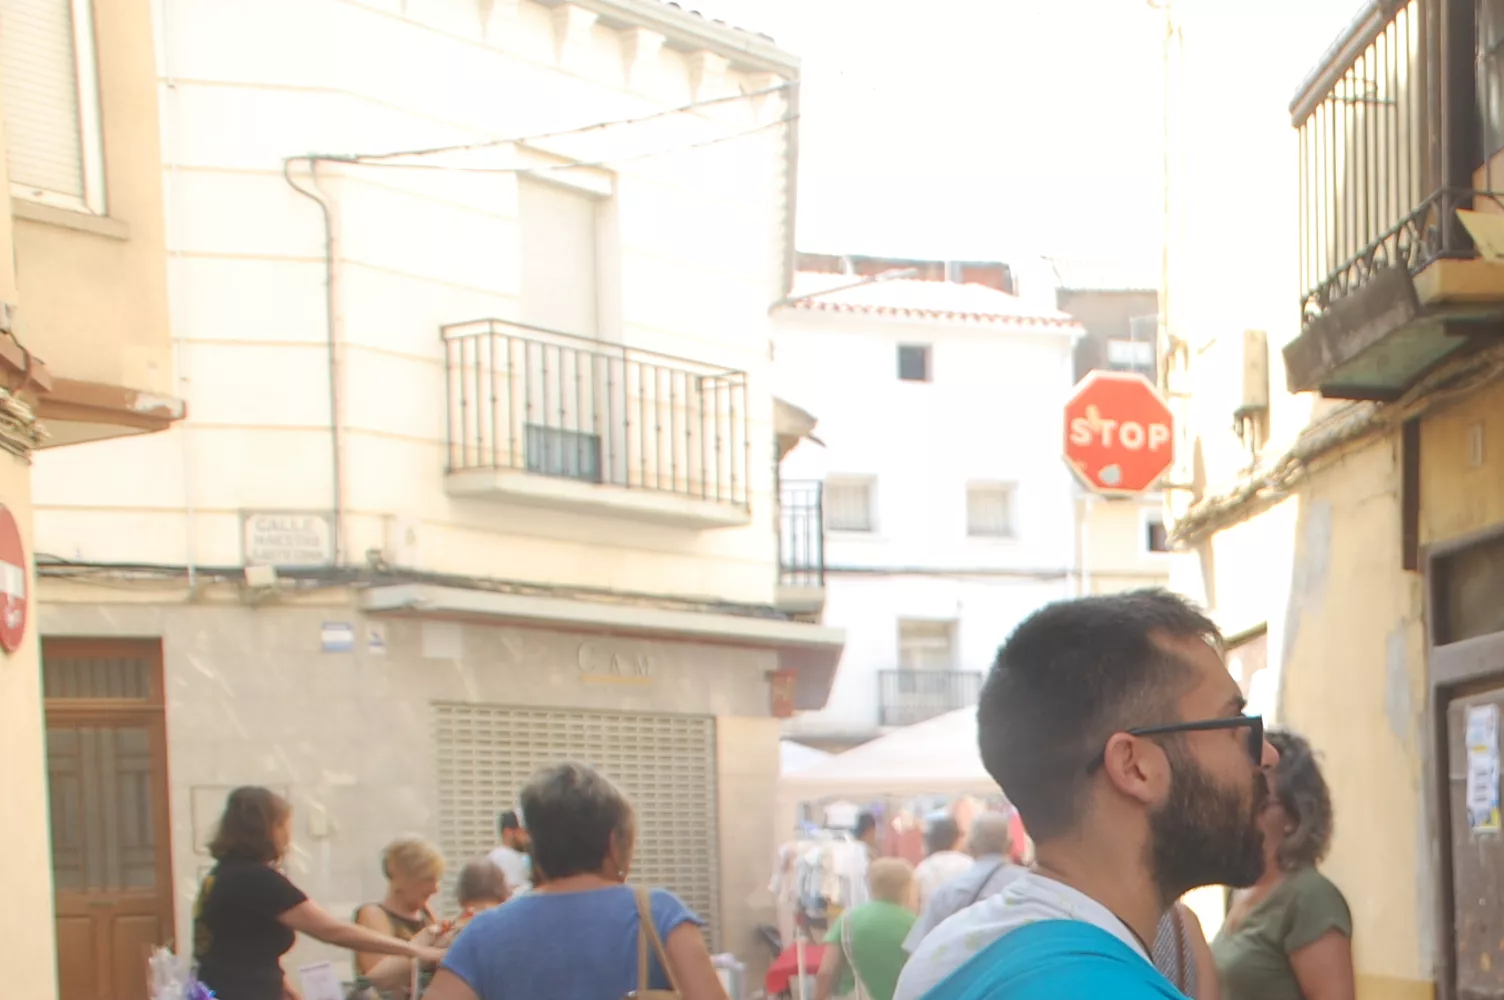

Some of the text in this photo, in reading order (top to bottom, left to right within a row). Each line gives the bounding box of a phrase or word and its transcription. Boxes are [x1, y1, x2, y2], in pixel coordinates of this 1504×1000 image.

[1070, 417, 1170, 452] STOP
[256, 517, 314, 532] CALLE
[576, 641, 650, 676] CAM
